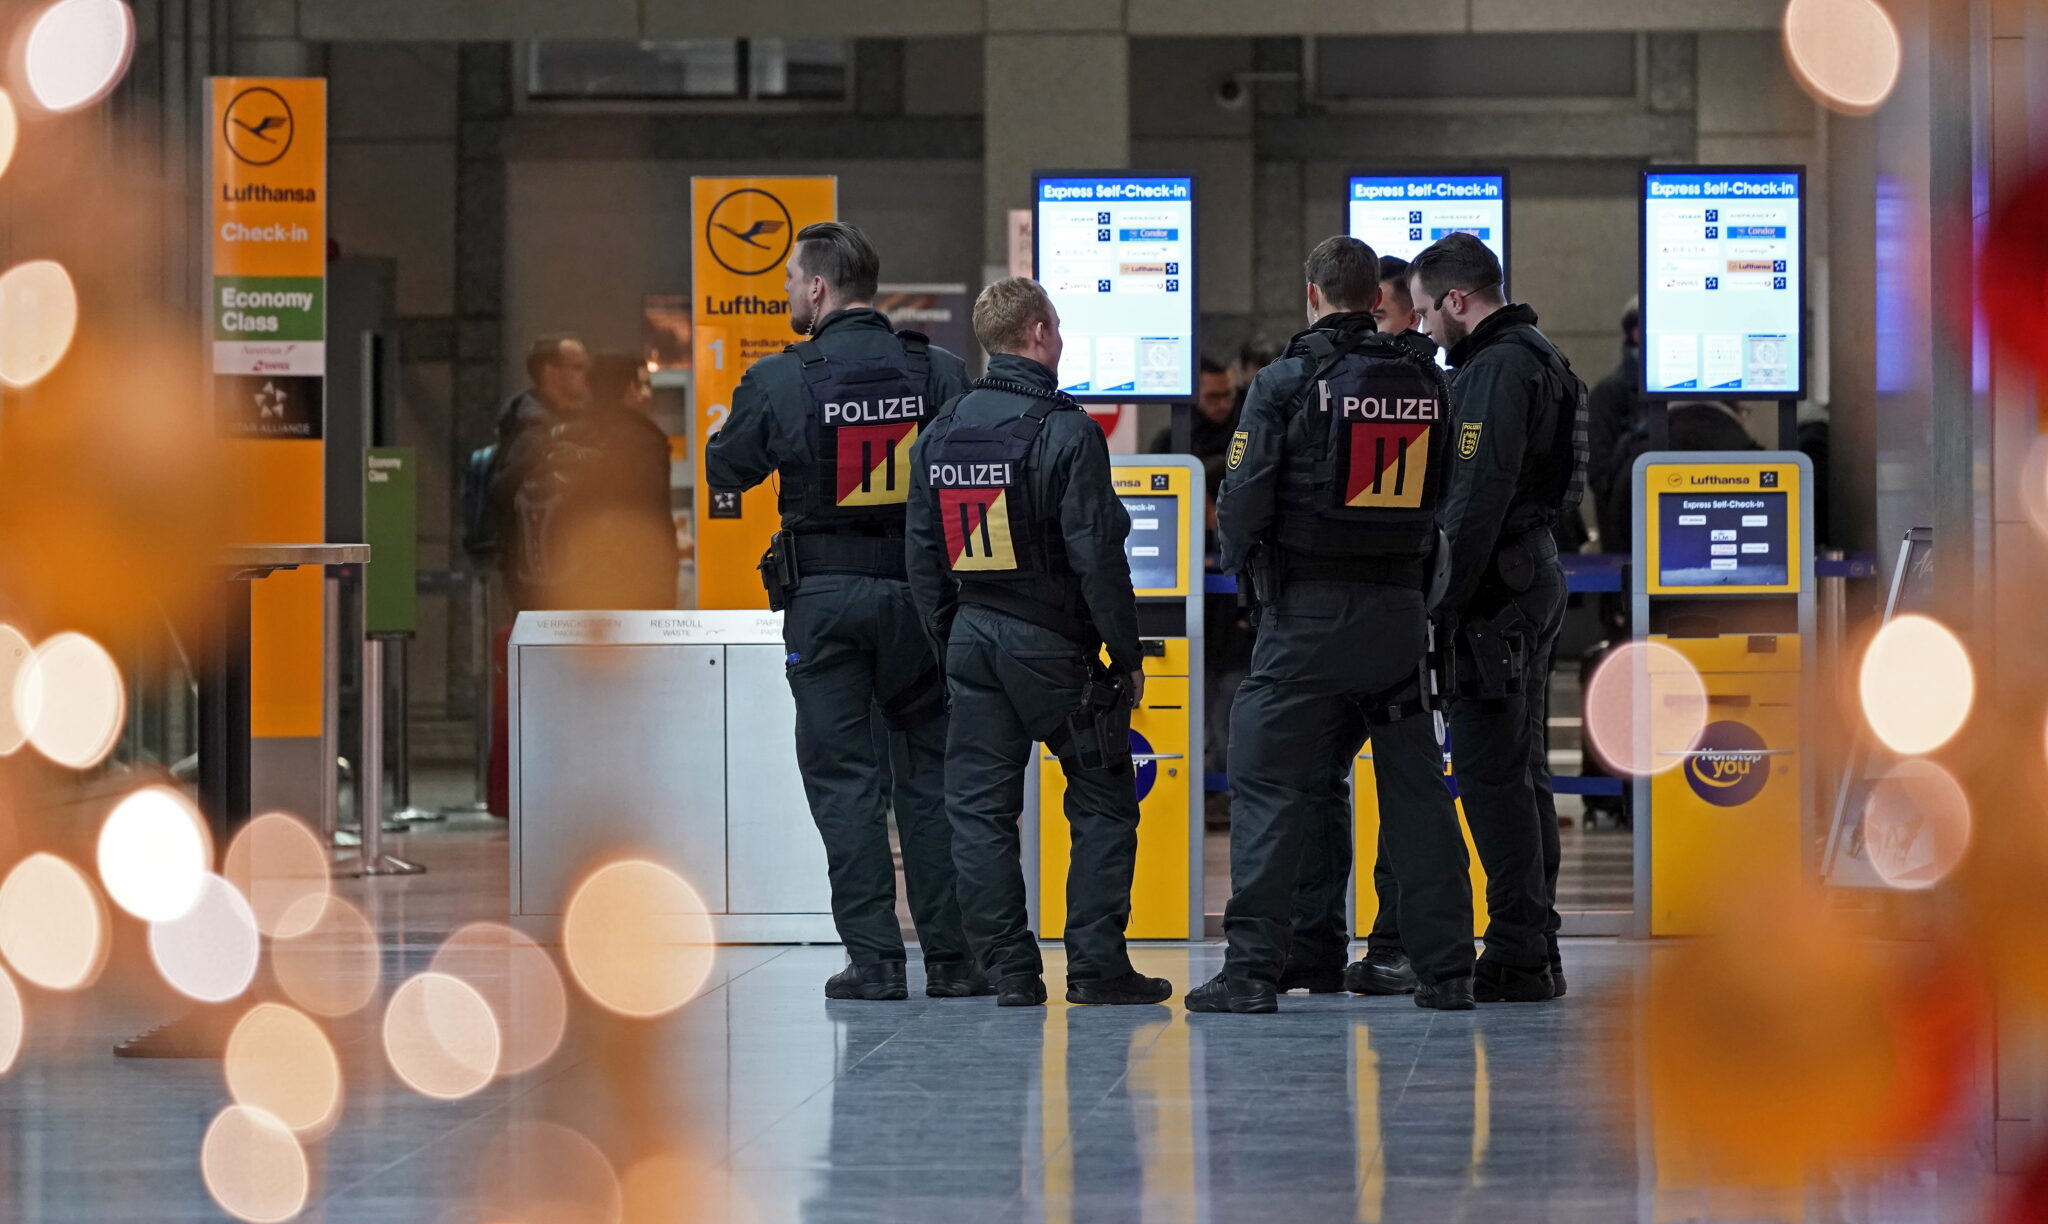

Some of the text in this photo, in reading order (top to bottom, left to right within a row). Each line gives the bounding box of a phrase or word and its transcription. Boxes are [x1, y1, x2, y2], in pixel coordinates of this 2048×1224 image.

[222, 183, 316, 202] Lufthansa
[1043, 184, 1187, 200] Express Self-Check-in
[1354, 183, 1498, 200] Express Self-Check-in
[1651, 181, 1795, 198] Express Self-Check-in
[220, 221, 309, 242] Check-in
[1747, 227, 1776, 236] Condor
[221, 286, 314, 312] Economy
[221, 311, 279, 332] Class
[707, 338, 724, 370] 1
[824, 395, 925, 424] POLIZEI
[1343, 396, 1439, 420] POLIZEI
[260, 421, 311, 436] ALLIANCE
[929, 463, 1011, 486] POLIZEI
[1690, 475, 1750, 486] Lufthansa
[1683, 500, 1765, 510] Express Self-Check-in
[535, 618, 622, 629] VERPACKGEN
[650, 618, 703, 628] RESTMÜLL
[662, 629, 690, 637] WASTE
[1712, 759, 1750, 778] you
